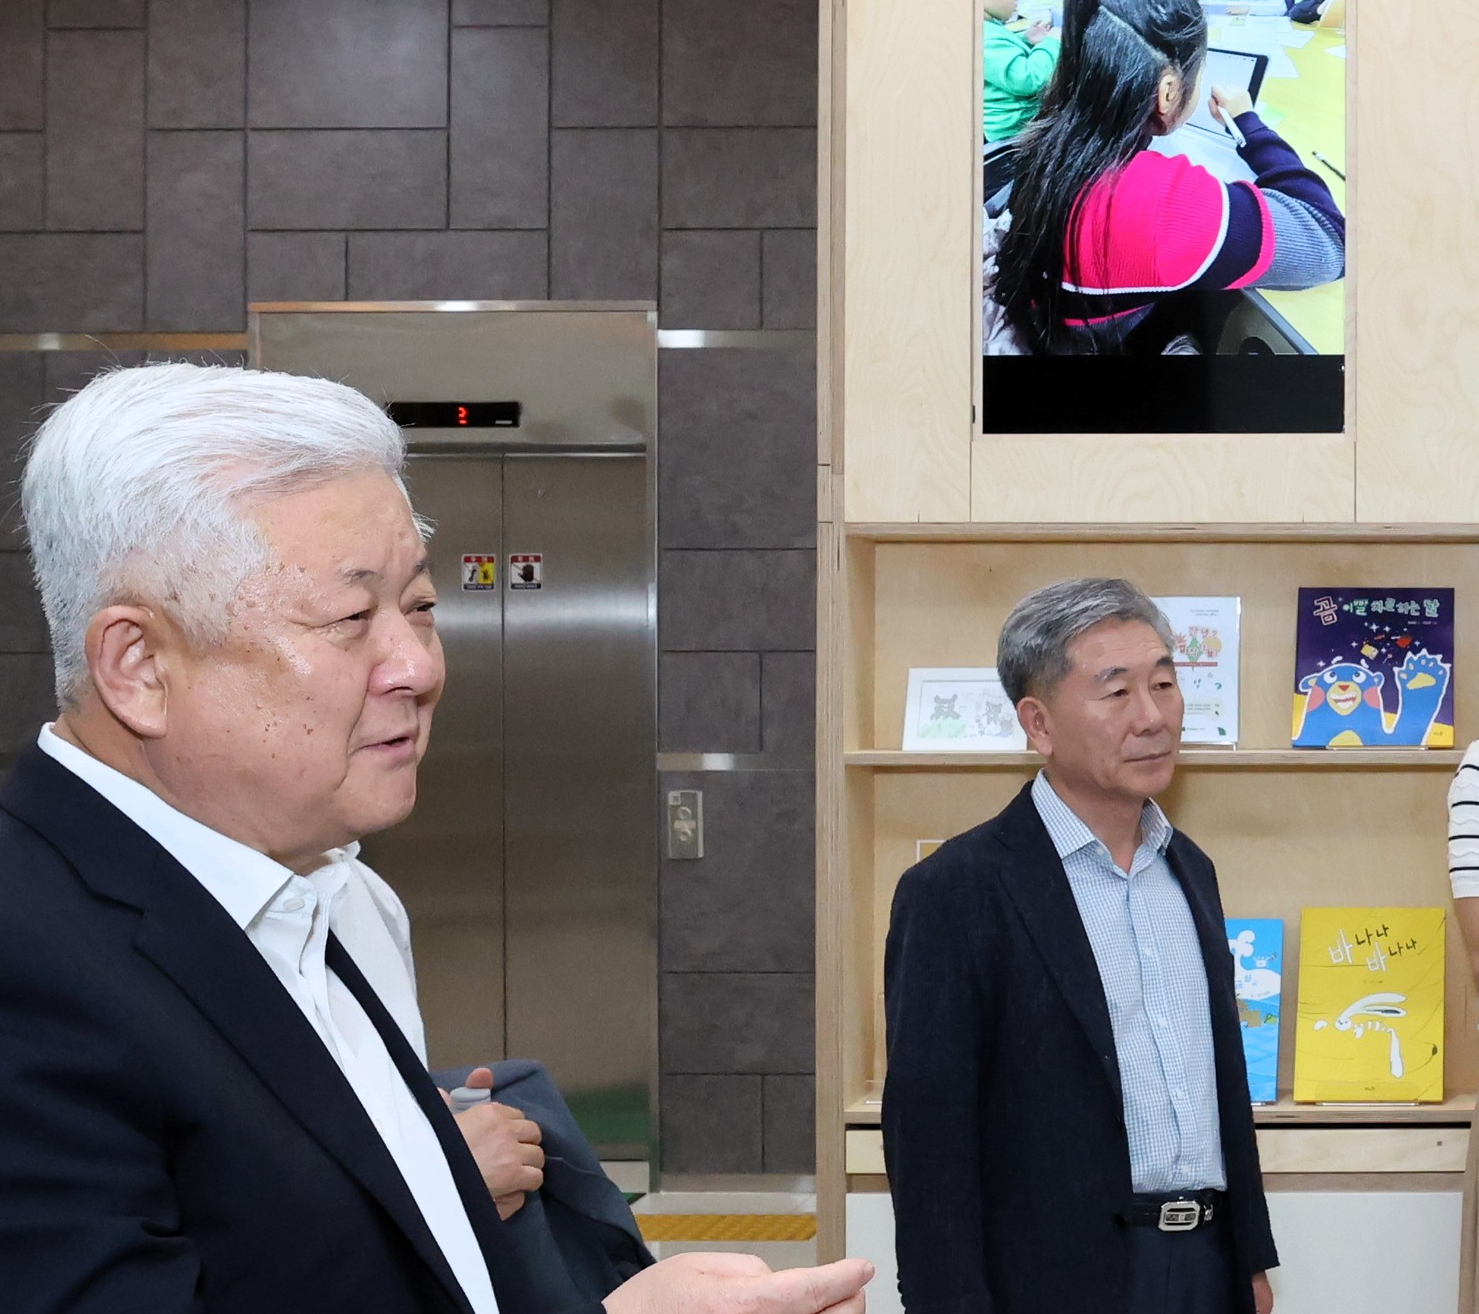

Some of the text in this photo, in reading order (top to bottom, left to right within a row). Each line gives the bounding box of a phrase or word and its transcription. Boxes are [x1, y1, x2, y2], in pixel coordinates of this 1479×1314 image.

[1313, 596, 1337, 626] 곰
[1327, 923, 1390, 965] 바나나
[1365, 937, 1418, 973] 바나나
